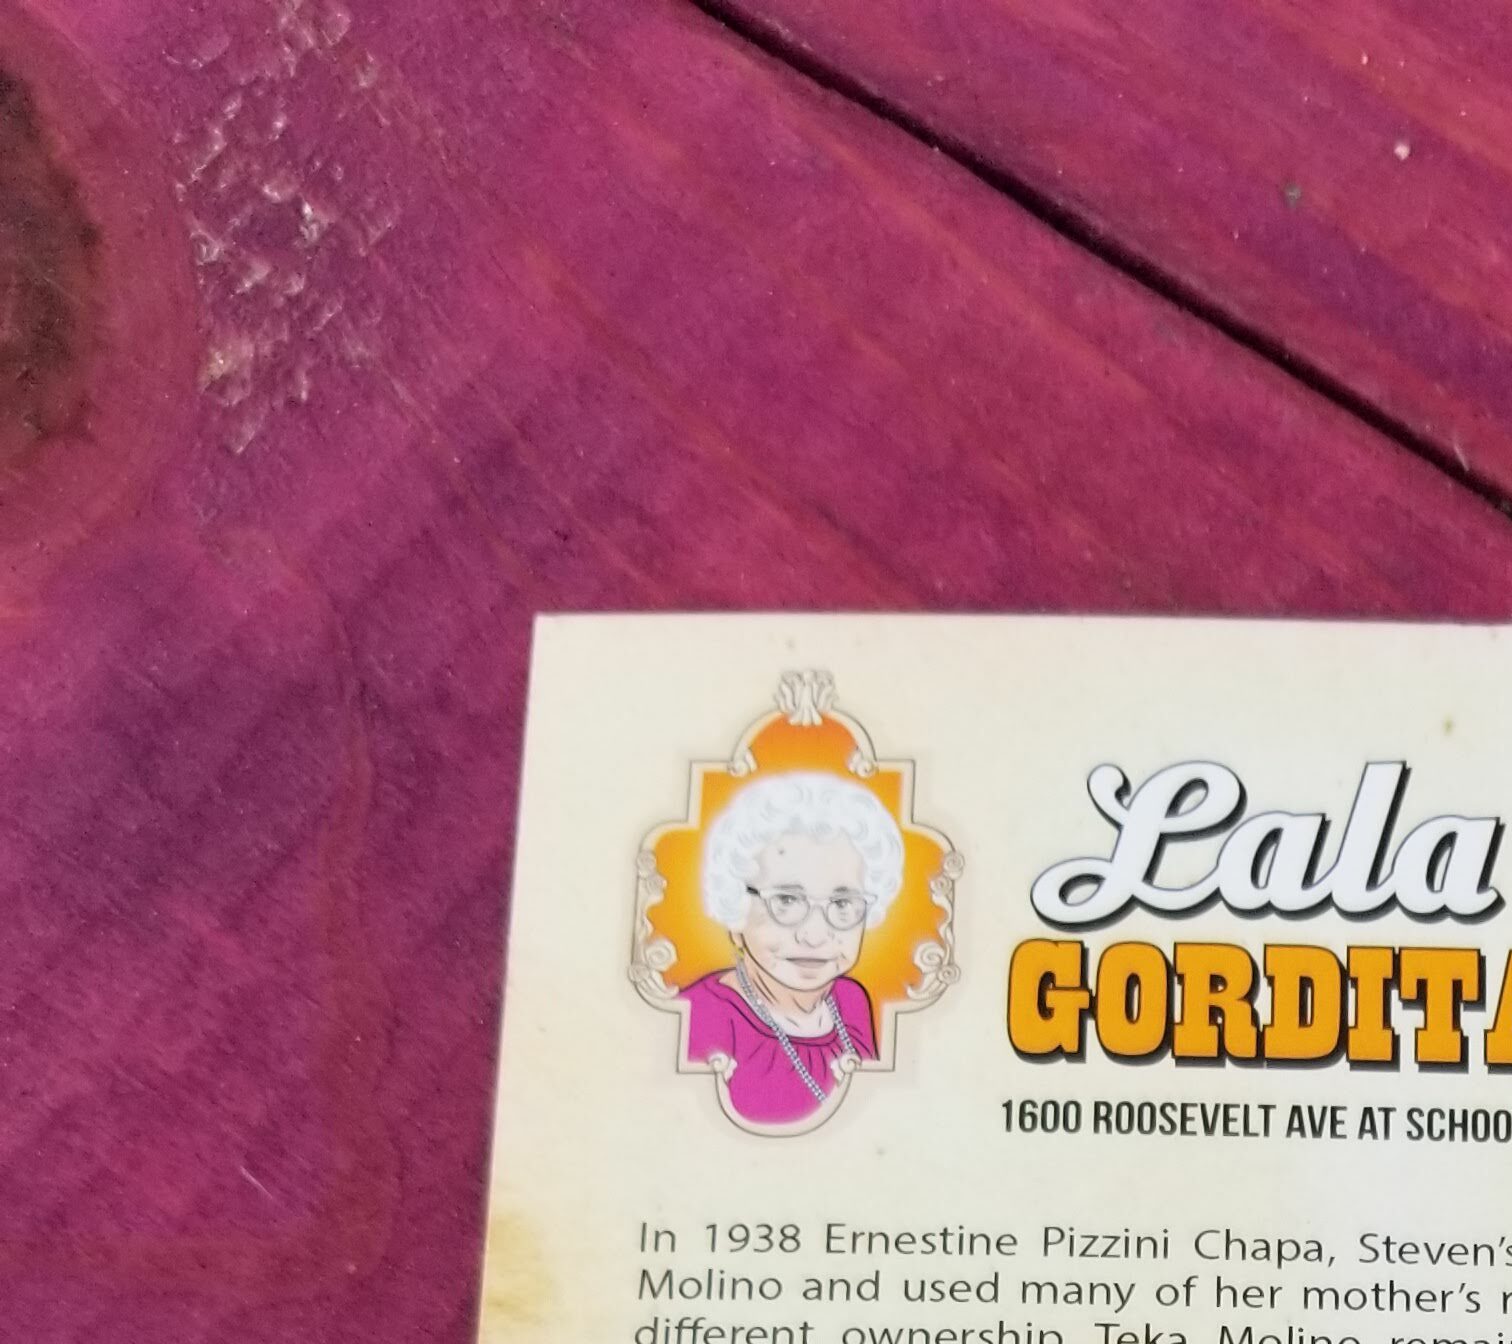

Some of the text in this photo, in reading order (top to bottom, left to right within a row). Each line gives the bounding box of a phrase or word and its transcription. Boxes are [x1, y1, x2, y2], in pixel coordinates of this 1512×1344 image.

[1003, 1100, 1083, 1134] 1600
[1094, 1101, 1278, 1138] ROOSEVELT
[1287, 1105, 1348, 1140] AVE
[1359, 1107, 1398, 1141] AT
[640, 1222, 676, 1252] In
[706, 1223, 801, 1253] 1938
[826, 1223, 1017, 1256] Ernestine
[1043, 1226, 1168, 1259] Pizzini
[1194, 1228, 1335, 1269] Chapa,
